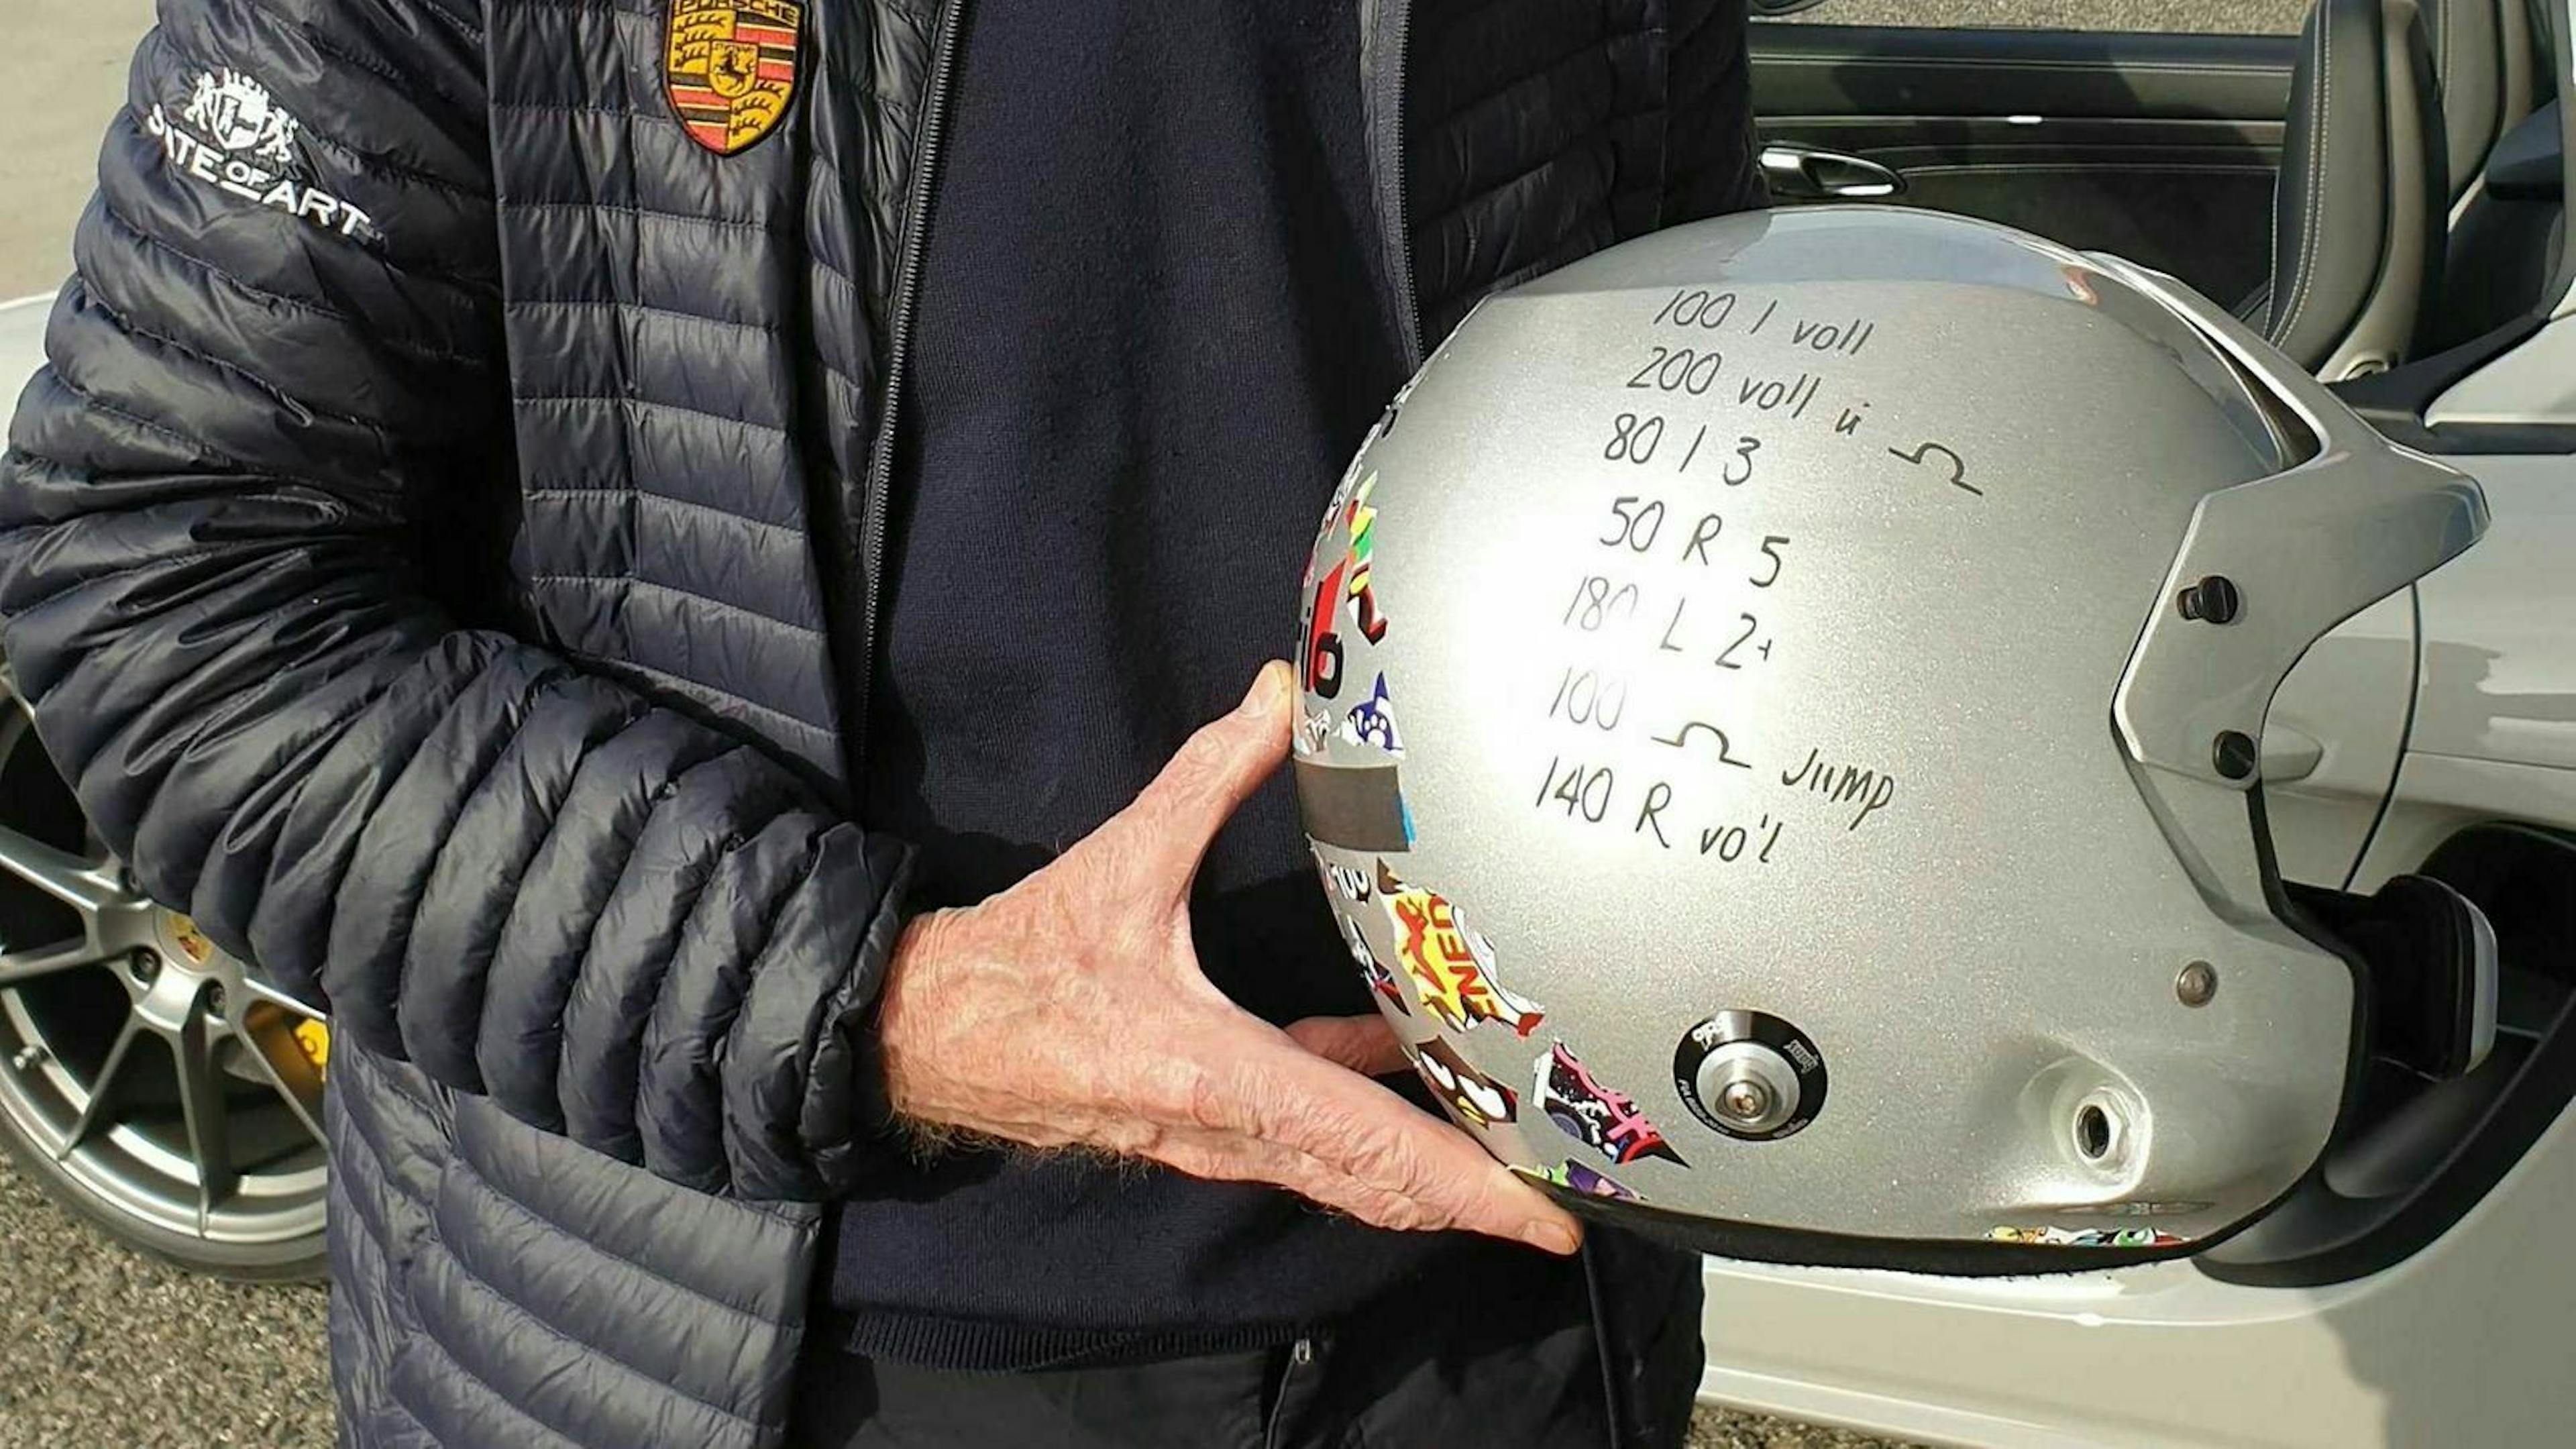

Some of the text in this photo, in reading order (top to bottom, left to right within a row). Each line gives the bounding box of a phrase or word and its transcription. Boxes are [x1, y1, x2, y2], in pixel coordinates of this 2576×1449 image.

[225, 160, 270, 187] OF
[262, 179, 372, 235] ART
[1652, 289, 1736, 330] 100
[1625, 345, 1723, 396] 200
[1603, 412, 1666, 466] 80
[1722, 435, 1762, 487] 3
[1599, 496, 1791, 590] 50 R 5
[1658, 597, 1685, 652] L
[1548, 667, 1627, 732] 100
[1535, 755, 1614, 824] 140
[1634, 781, 1672, 850] R
